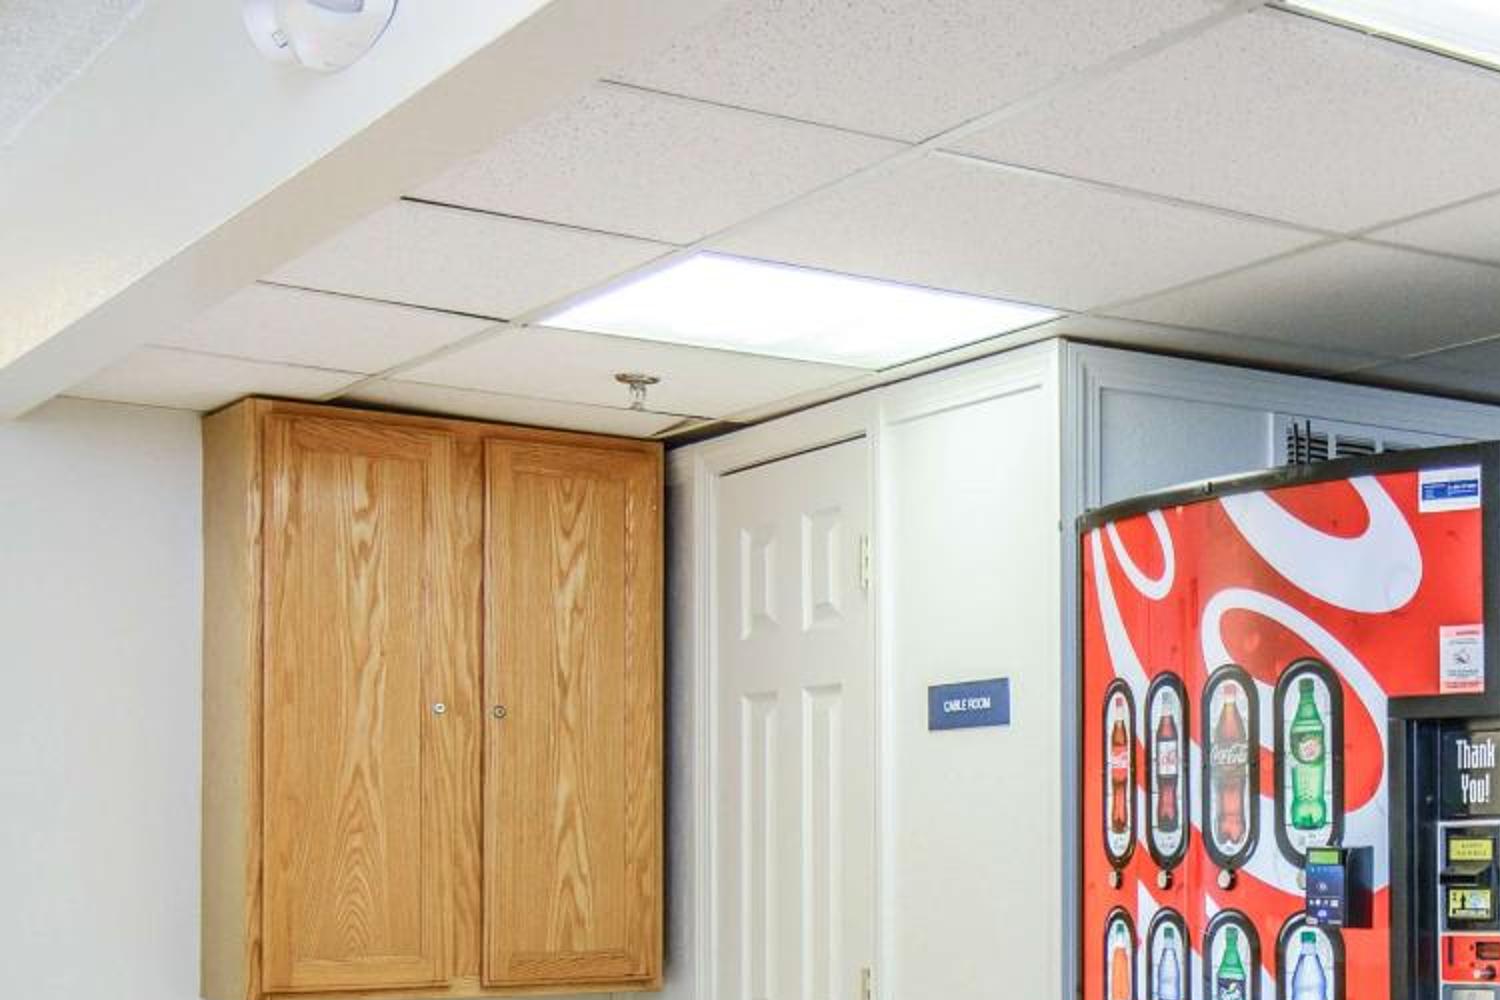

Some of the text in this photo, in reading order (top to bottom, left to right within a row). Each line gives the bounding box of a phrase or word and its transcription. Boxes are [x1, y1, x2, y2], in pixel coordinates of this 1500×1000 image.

[943, 697, 991, 712] CABLE ROOM
[1456, 738, 1495, 769] Thank
[1461, 773, 1490, 805] You!
